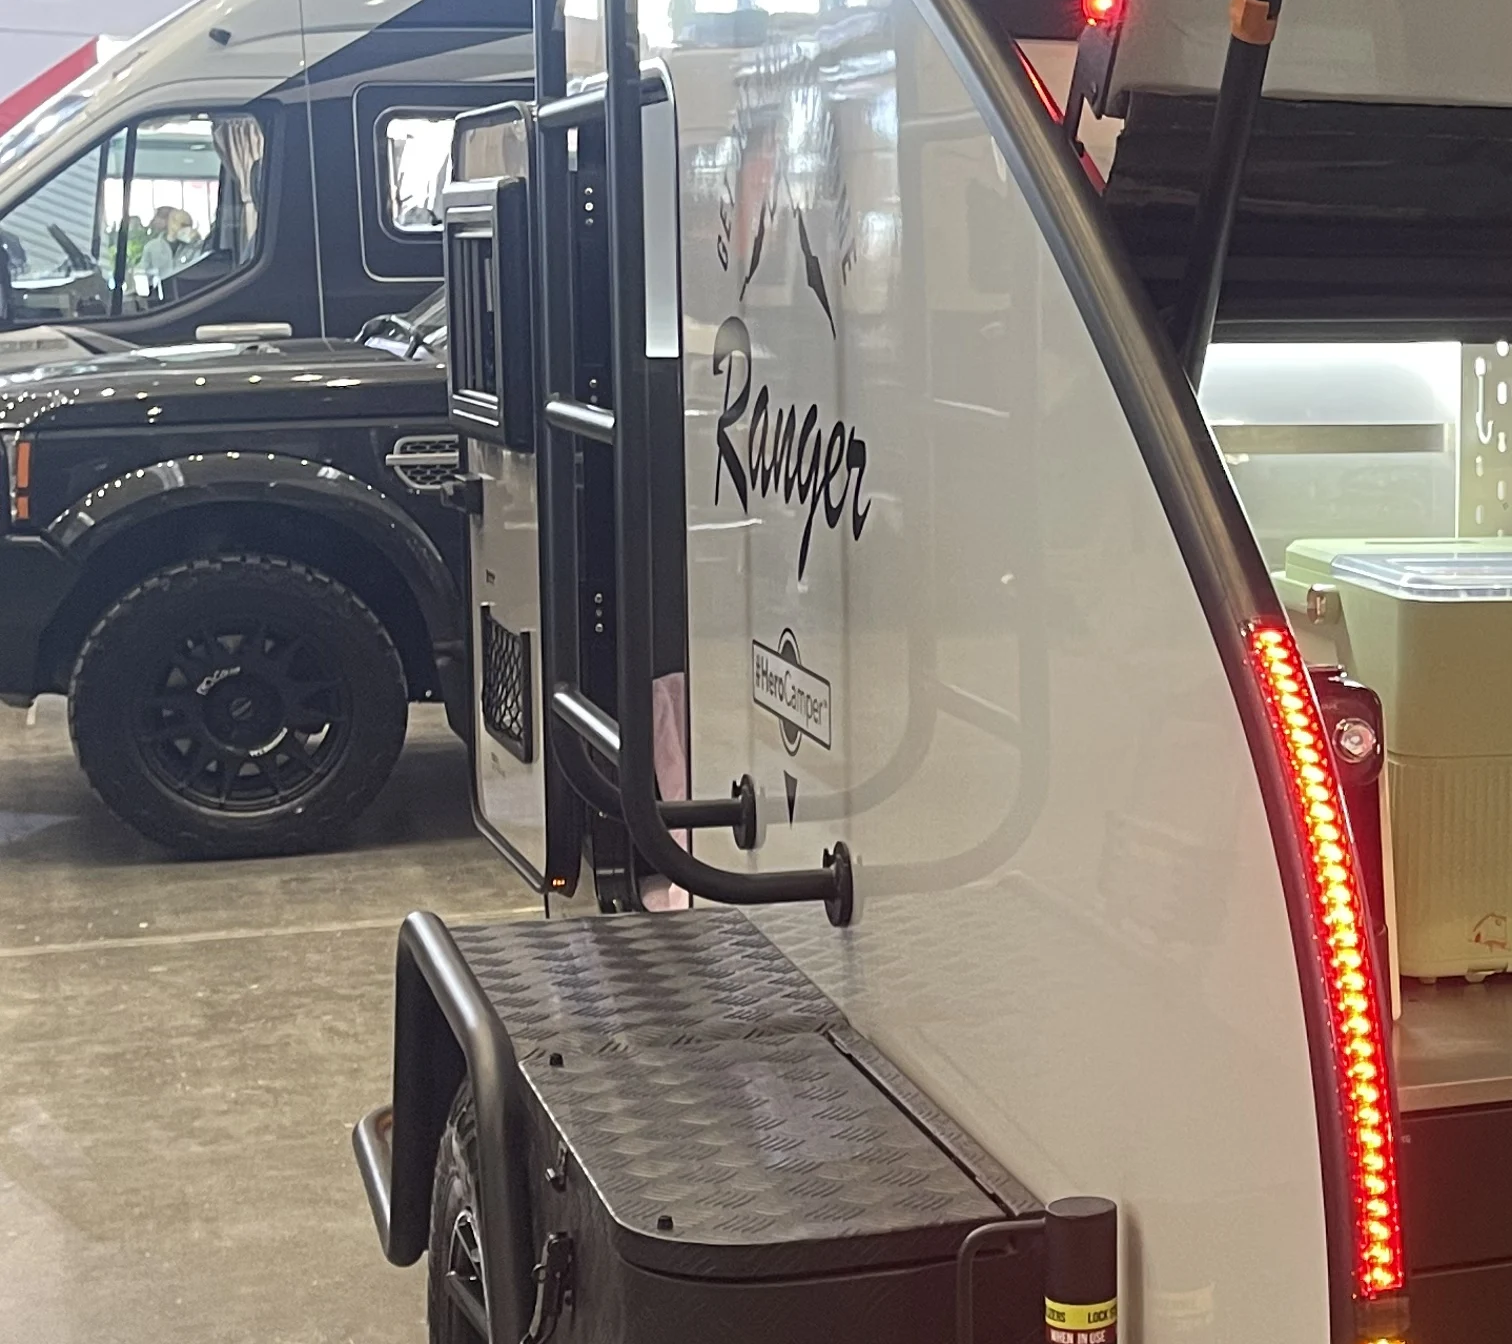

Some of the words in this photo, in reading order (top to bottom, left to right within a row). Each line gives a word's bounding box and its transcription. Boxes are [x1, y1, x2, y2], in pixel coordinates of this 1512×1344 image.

[713, 315, 872, 582] Ranger
[1087, 1309, 1108, 1324] LOCK
[1077, 1332, 1088, 1344] IN
[1089, 1329, 1106, 1344] USE
